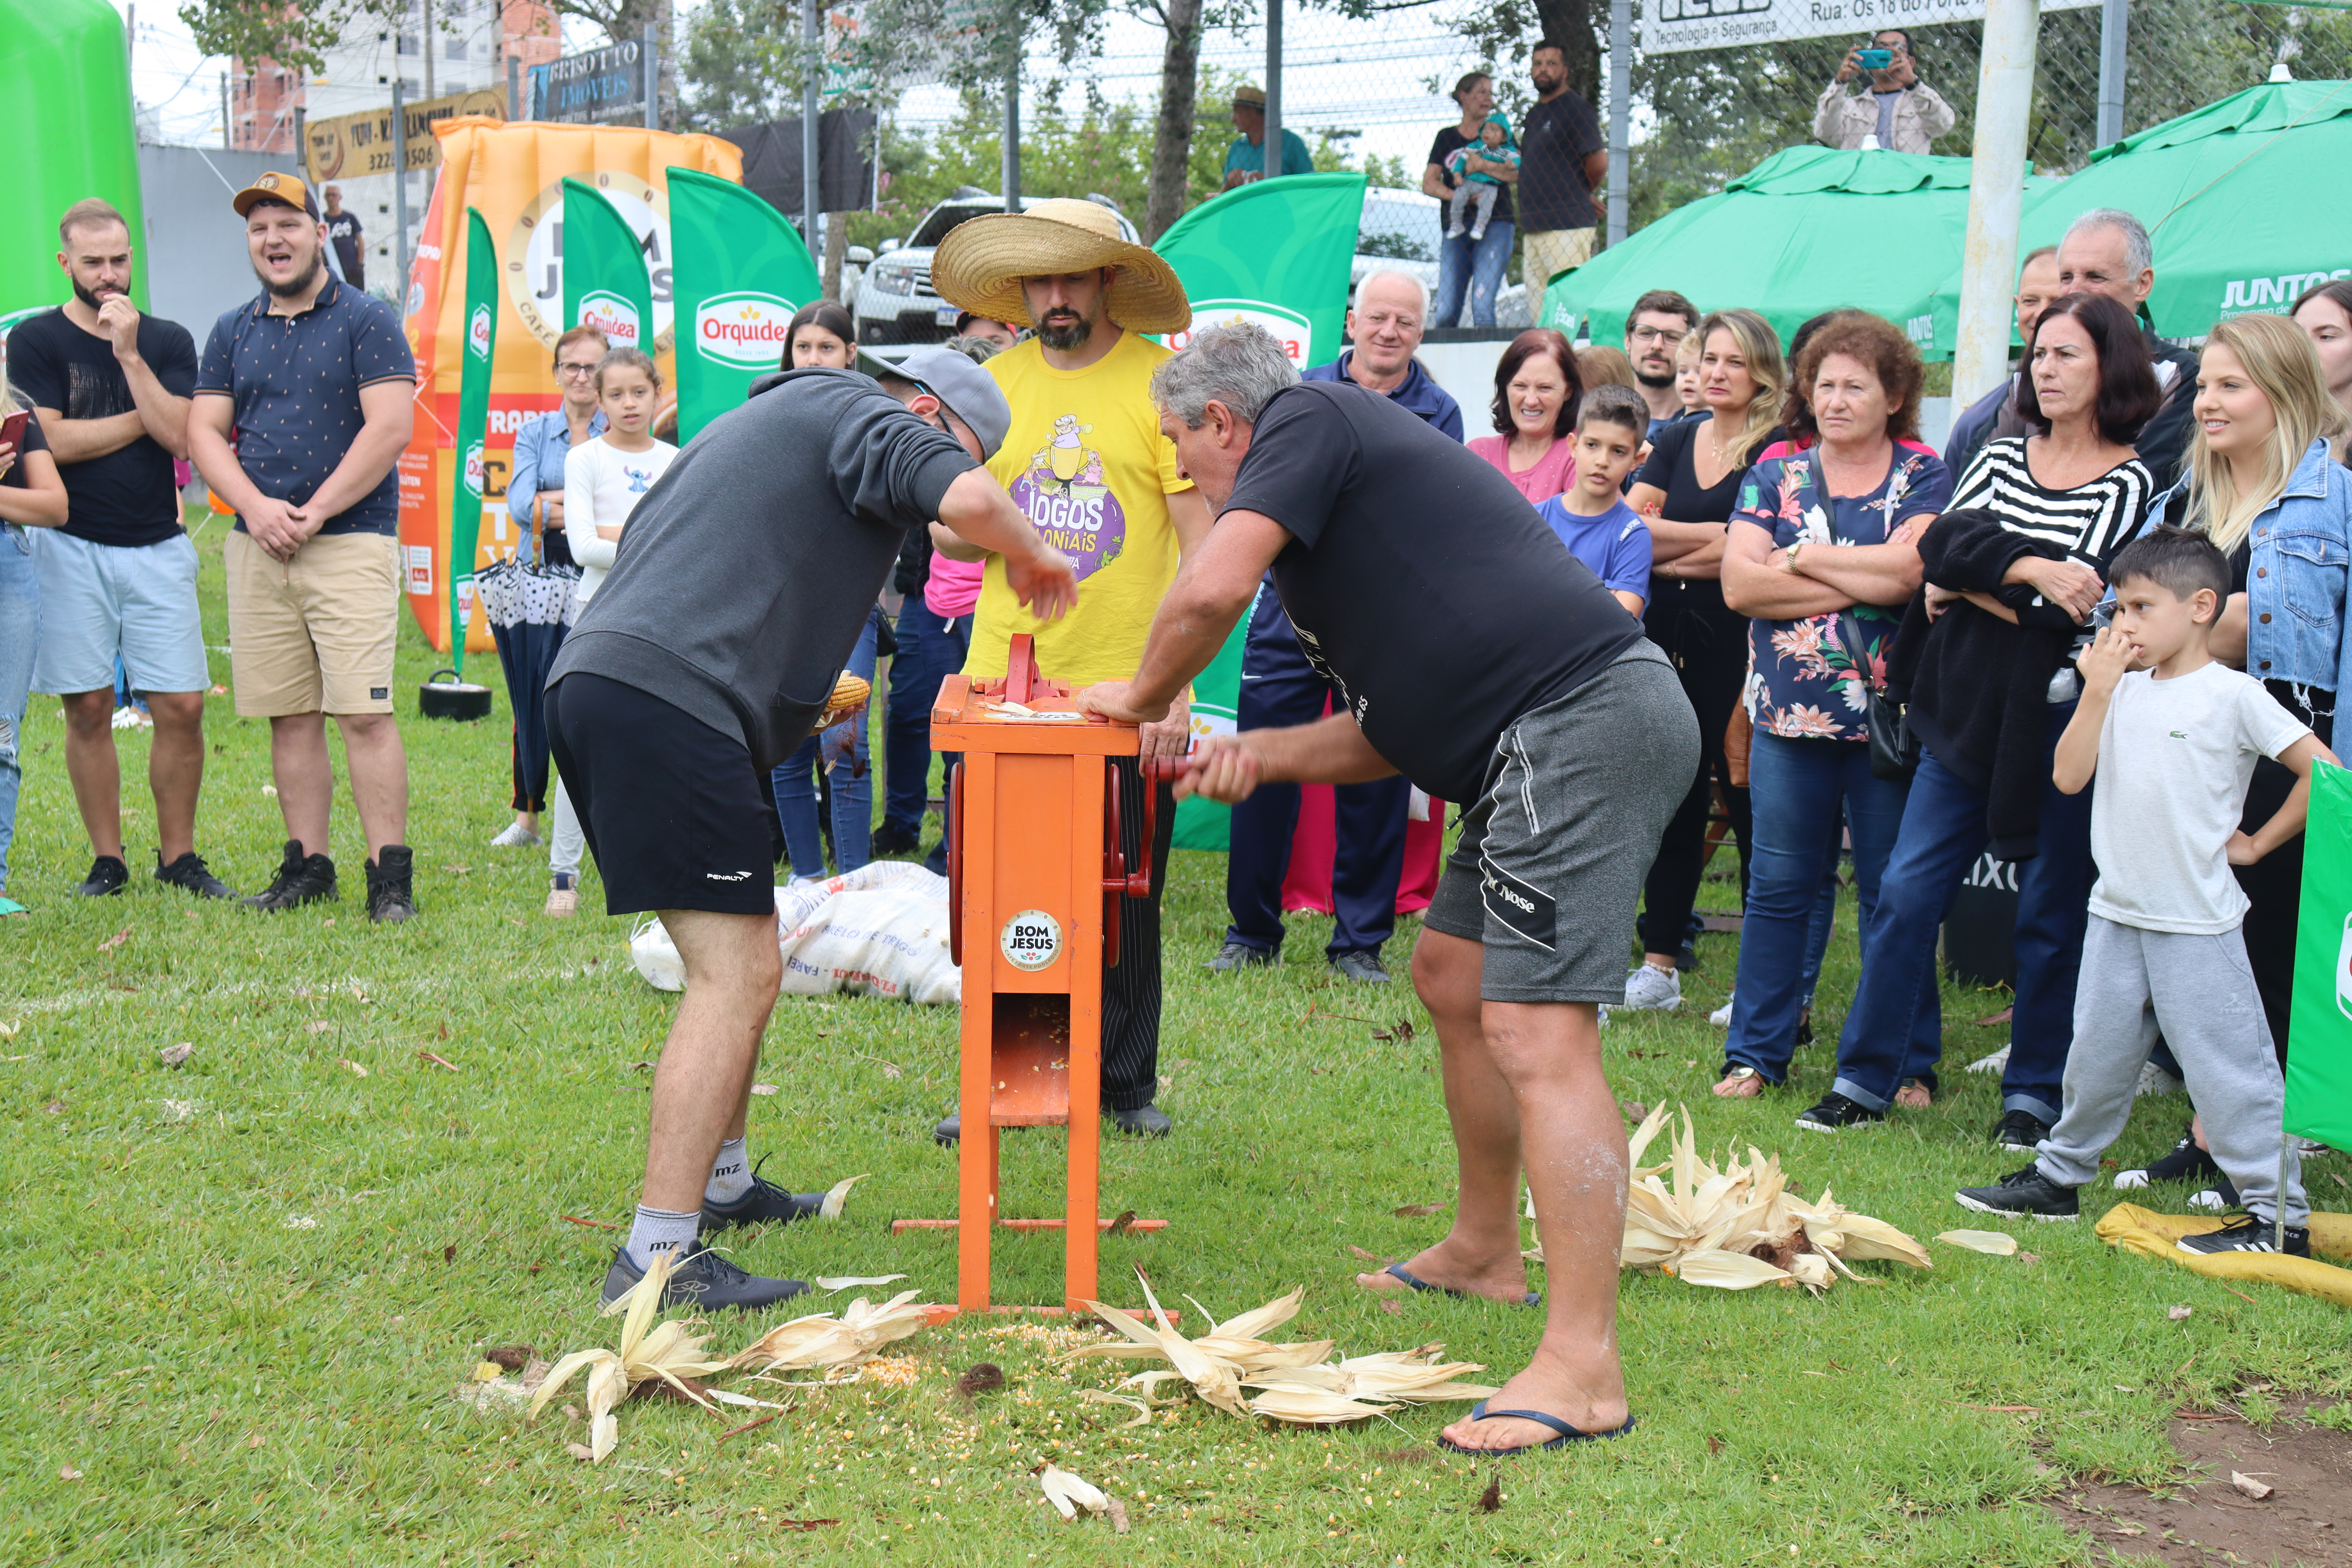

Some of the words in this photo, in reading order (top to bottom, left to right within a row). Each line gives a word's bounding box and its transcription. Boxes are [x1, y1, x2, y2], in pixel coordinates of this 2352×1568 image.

[1811, 2, 1847, 21] Rua:
[1853, 0, 1873, 17] Os
[1655, 25, 1709, 45] Tecnologia
[1712, 26, 1718, 36] e
[1722, 20, 1777, 40] Segurança
[2276, 305, 2290, 314] de
[703, 318, 789, 346] Orquide
[1020, 490, 1105, 532] JOGOS
[1358, 695, 1368, 711] 65
[707, 873, 744, 882] PENALTY
[1015, 926, 1049, 937] BOM
[1009, 938, 1053, 950] JESUS
[1004, 949, 1015, 963] CAFÉ
[1014, 961, 1033, 969] FORTE
[1034, 949, 1059, 969] PODEROSO
[715, 1163, 740, 1177] mz
